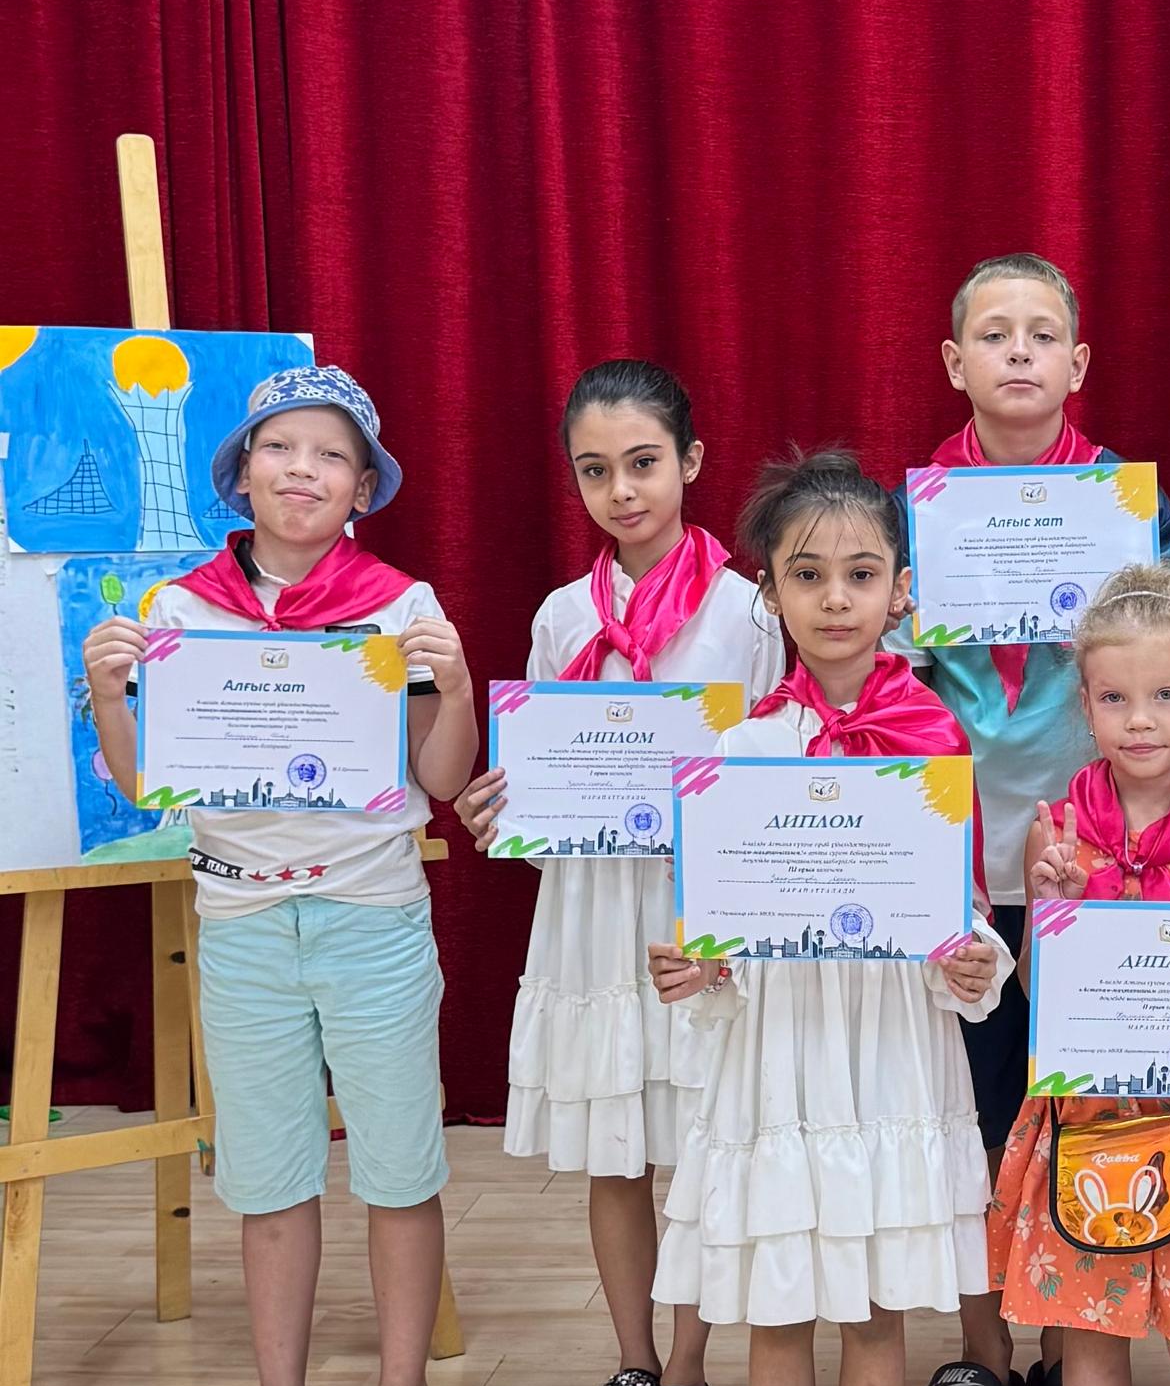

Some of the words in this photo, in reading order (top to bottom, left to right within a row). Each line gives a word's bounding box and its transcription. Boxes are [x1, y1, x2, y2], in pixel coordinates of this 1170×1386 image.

[985, 515, 1032, 529] Алғыс
[1033, 515, 1064, 528] хат
[222, 678, 271, 694] Алғыс
[273, 681, 306, 694] хат
[570, 731, 656, 746] ДИПЛОМ
[763, 814, 864, 830] ДИПЛОМ
[936, 1367, 979, 1385] NIKE
